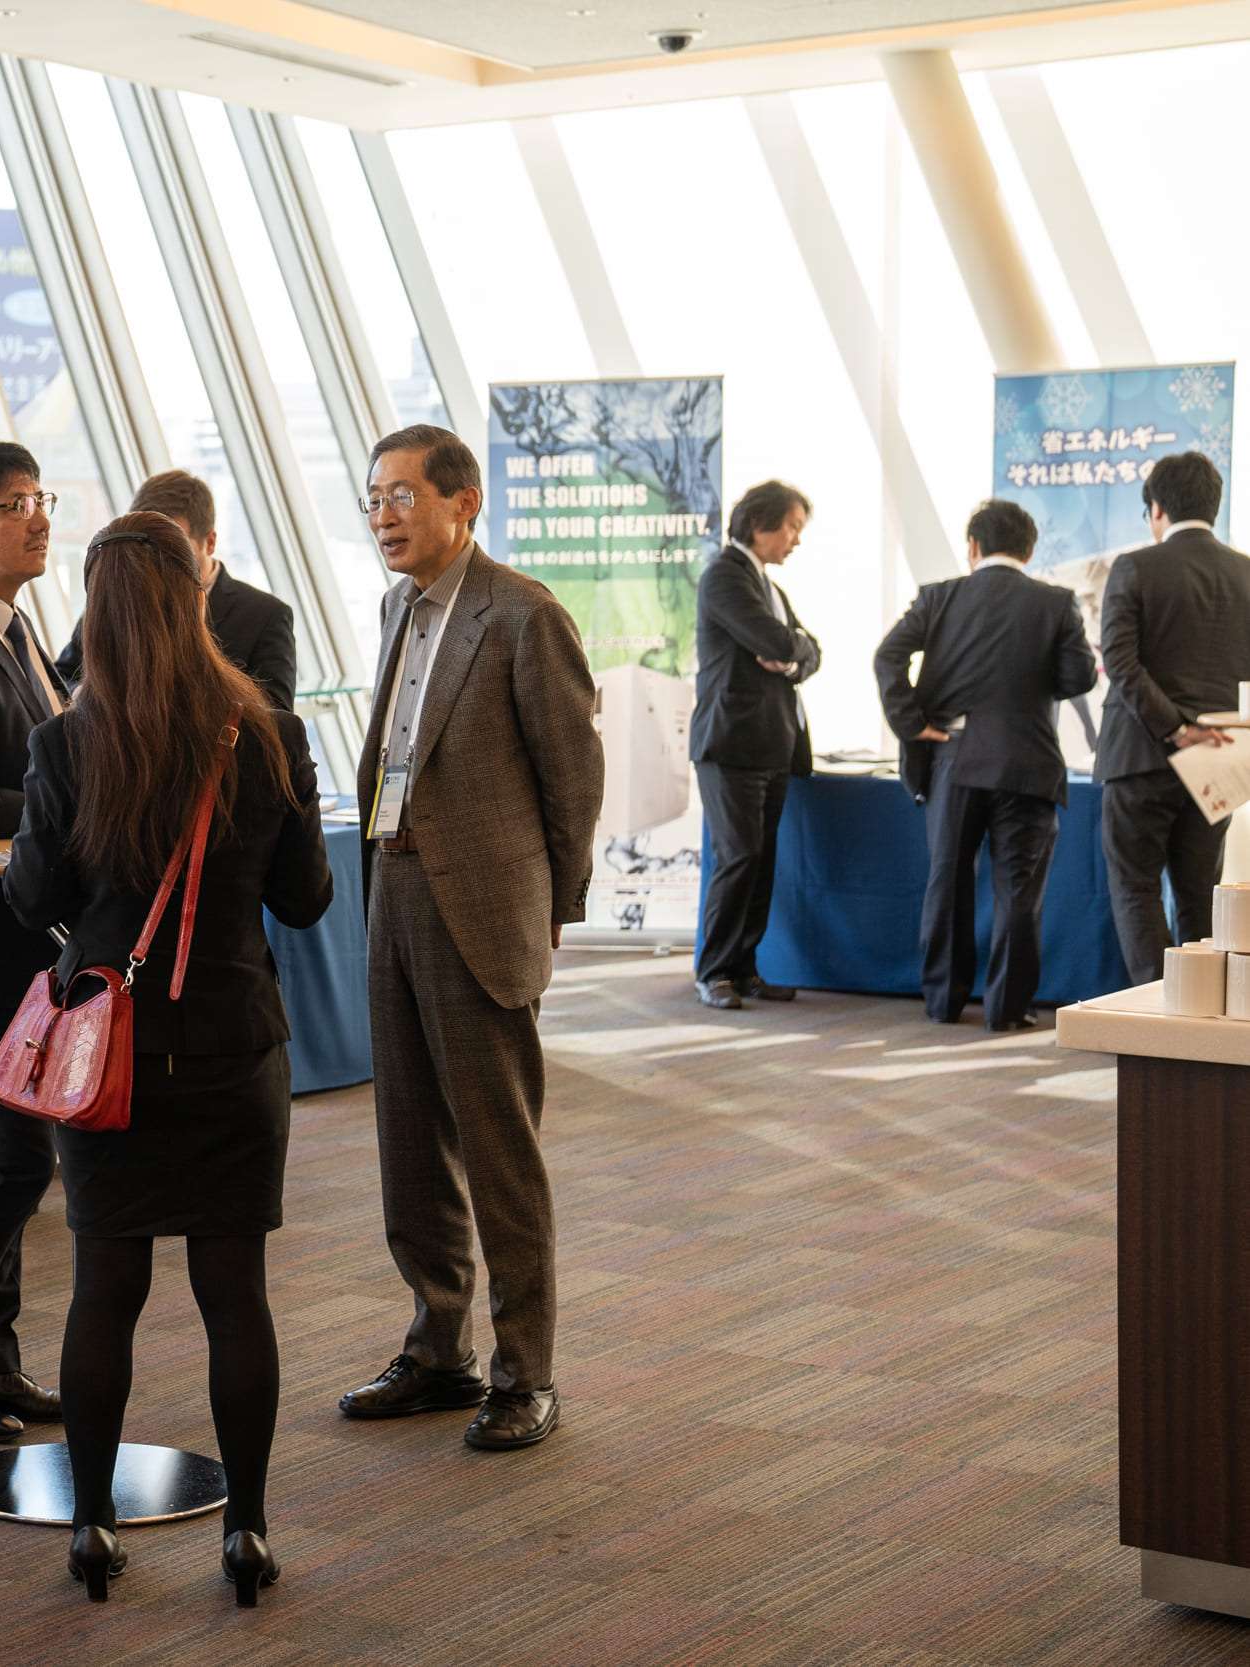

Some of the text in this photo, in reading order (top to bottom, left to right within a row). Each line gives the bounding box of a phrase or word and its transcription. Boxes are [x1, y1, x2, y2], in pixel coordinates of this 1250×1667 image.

[1042, 426, 1177, 454] 省エネルギー
[506, 455, 595, 478] WE OFFER
[506, 484, 648, 509] THE SOLUTIONS
[506, 514, 711, 540] FOR YOUR CREATIVITY.
